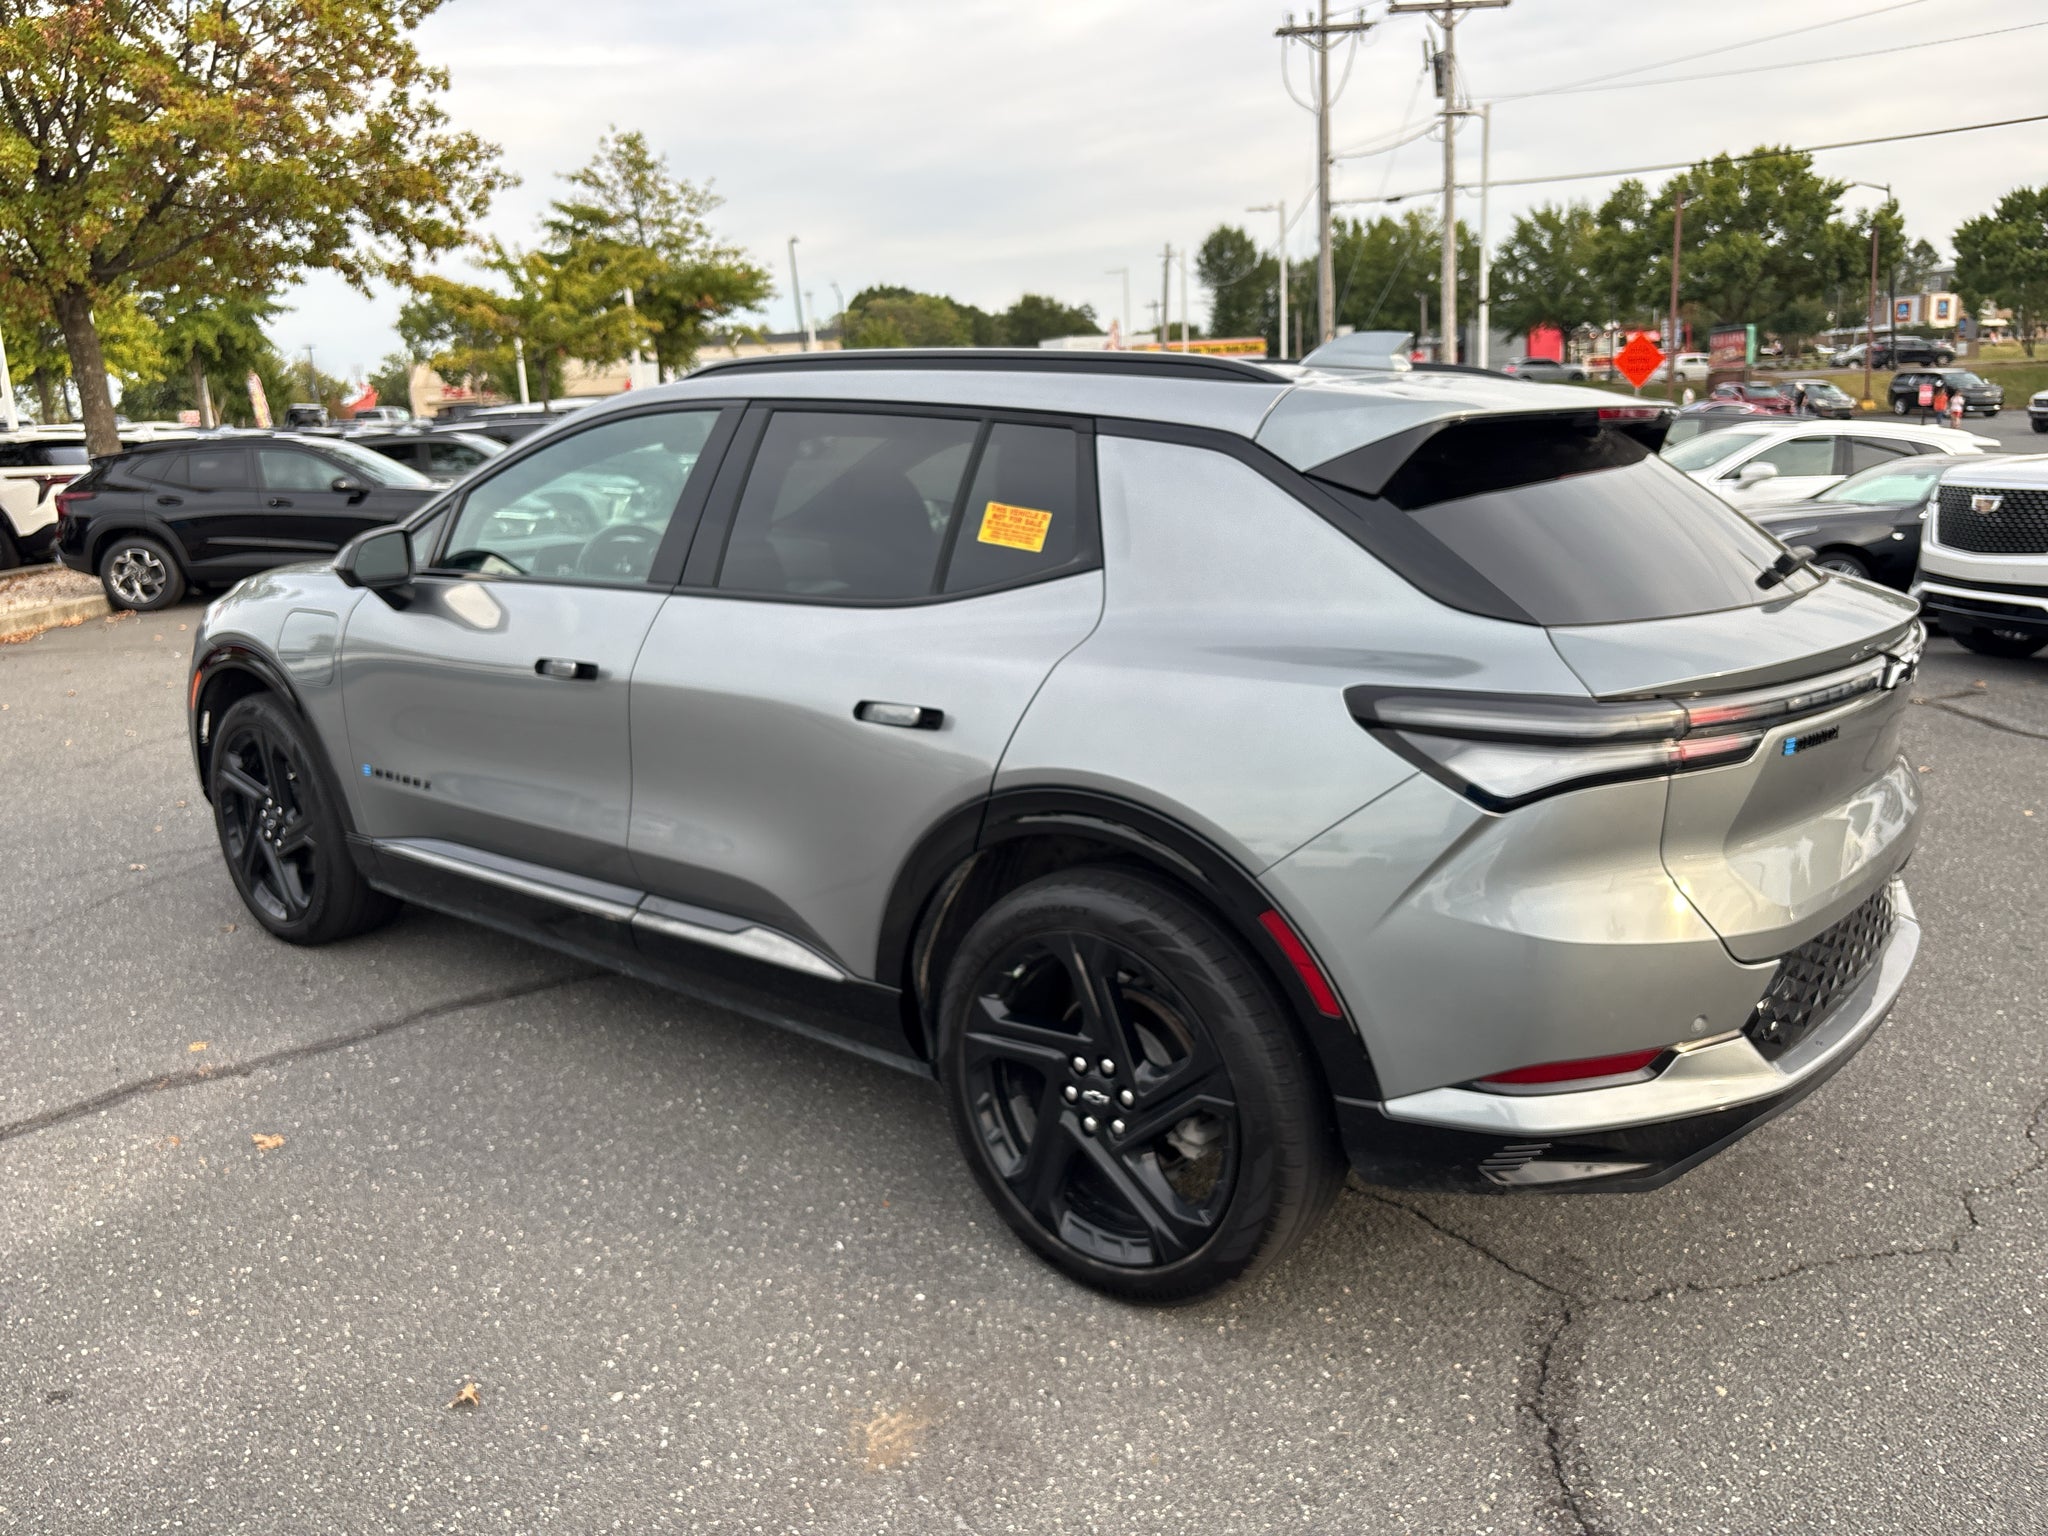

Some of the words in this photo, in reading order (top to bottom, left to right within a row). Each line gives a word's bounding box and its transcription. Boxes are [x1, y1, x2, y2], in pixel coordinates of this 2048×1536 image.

[1010, 508, 1039, 519] VEHICLE
[1009, 515, 1023, 524] FOR
[1025, 518, 1043, 528] SALE
[1016, 904, 1089, 919] CONTACT
